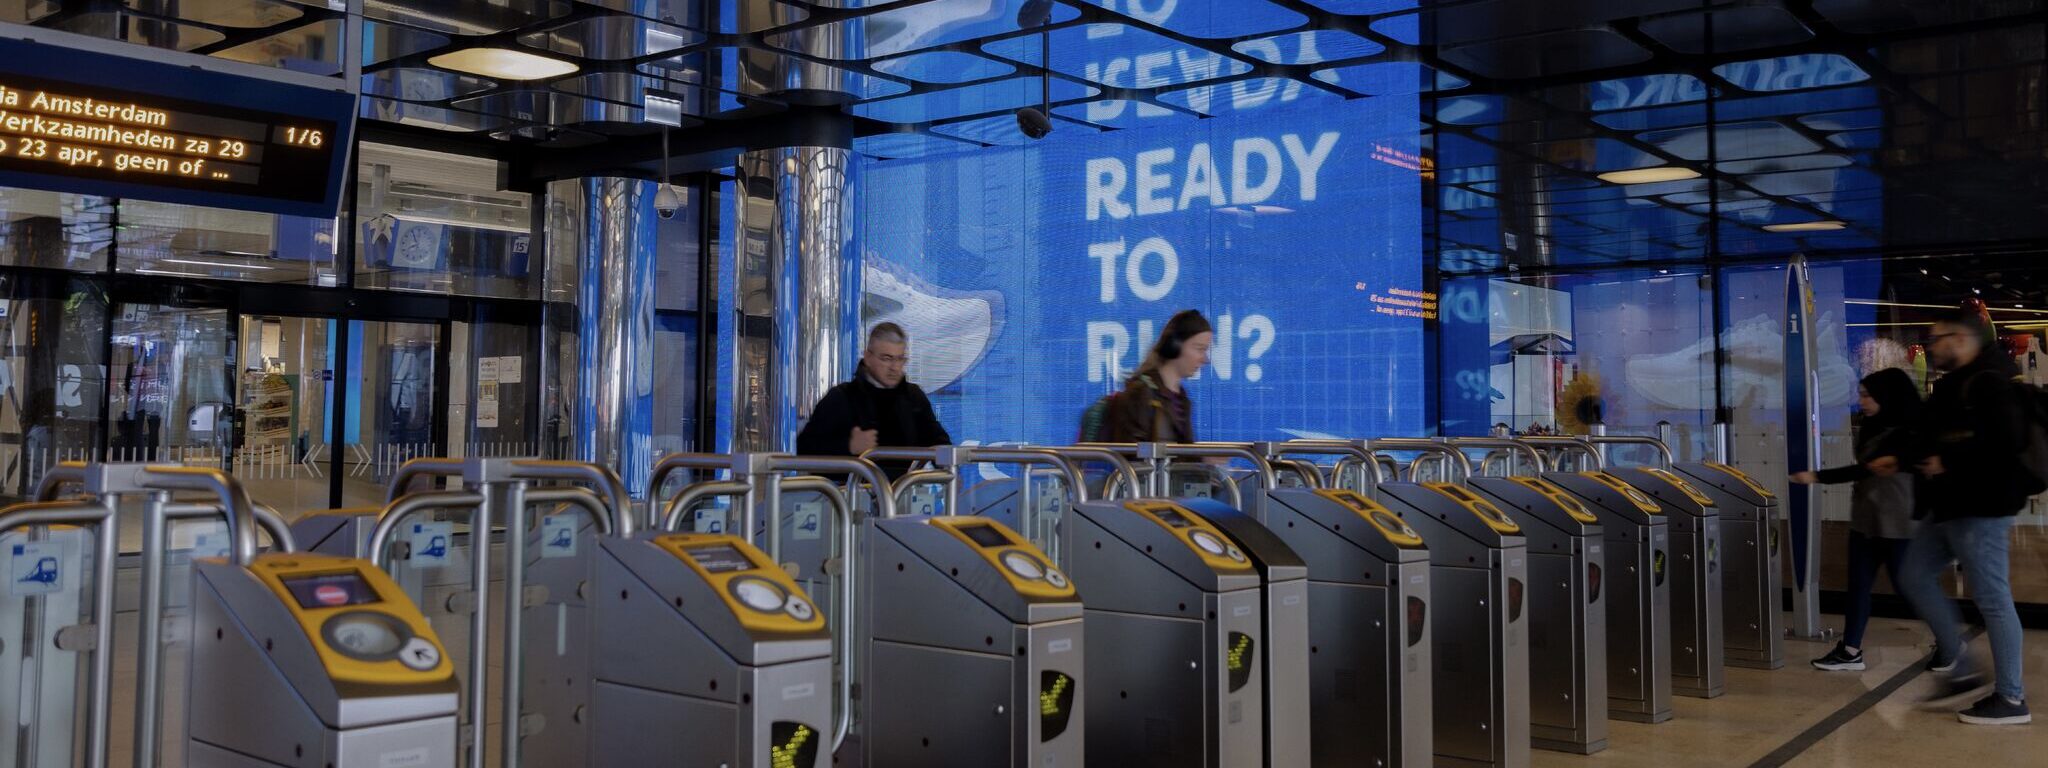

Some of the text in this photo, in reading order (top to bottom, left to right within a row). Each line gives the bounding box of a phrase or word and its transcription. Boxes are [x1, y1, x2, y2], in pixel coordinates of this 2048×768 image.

[31, 91, 167, 126] Amsterdam
[185, 139, 209, 154] za
[219, 140, 244, 158] 29
[286, 127, 322, 146] 1/6
[19, 138, 46, 157] 23
[58, 146, 103, 167] apr,
[115, 152, 169, 171] geen
[179, 159, 204, 175] of
[1086, 132, 1341, 221] READY
[1088, 236, 1179, 303] TO
